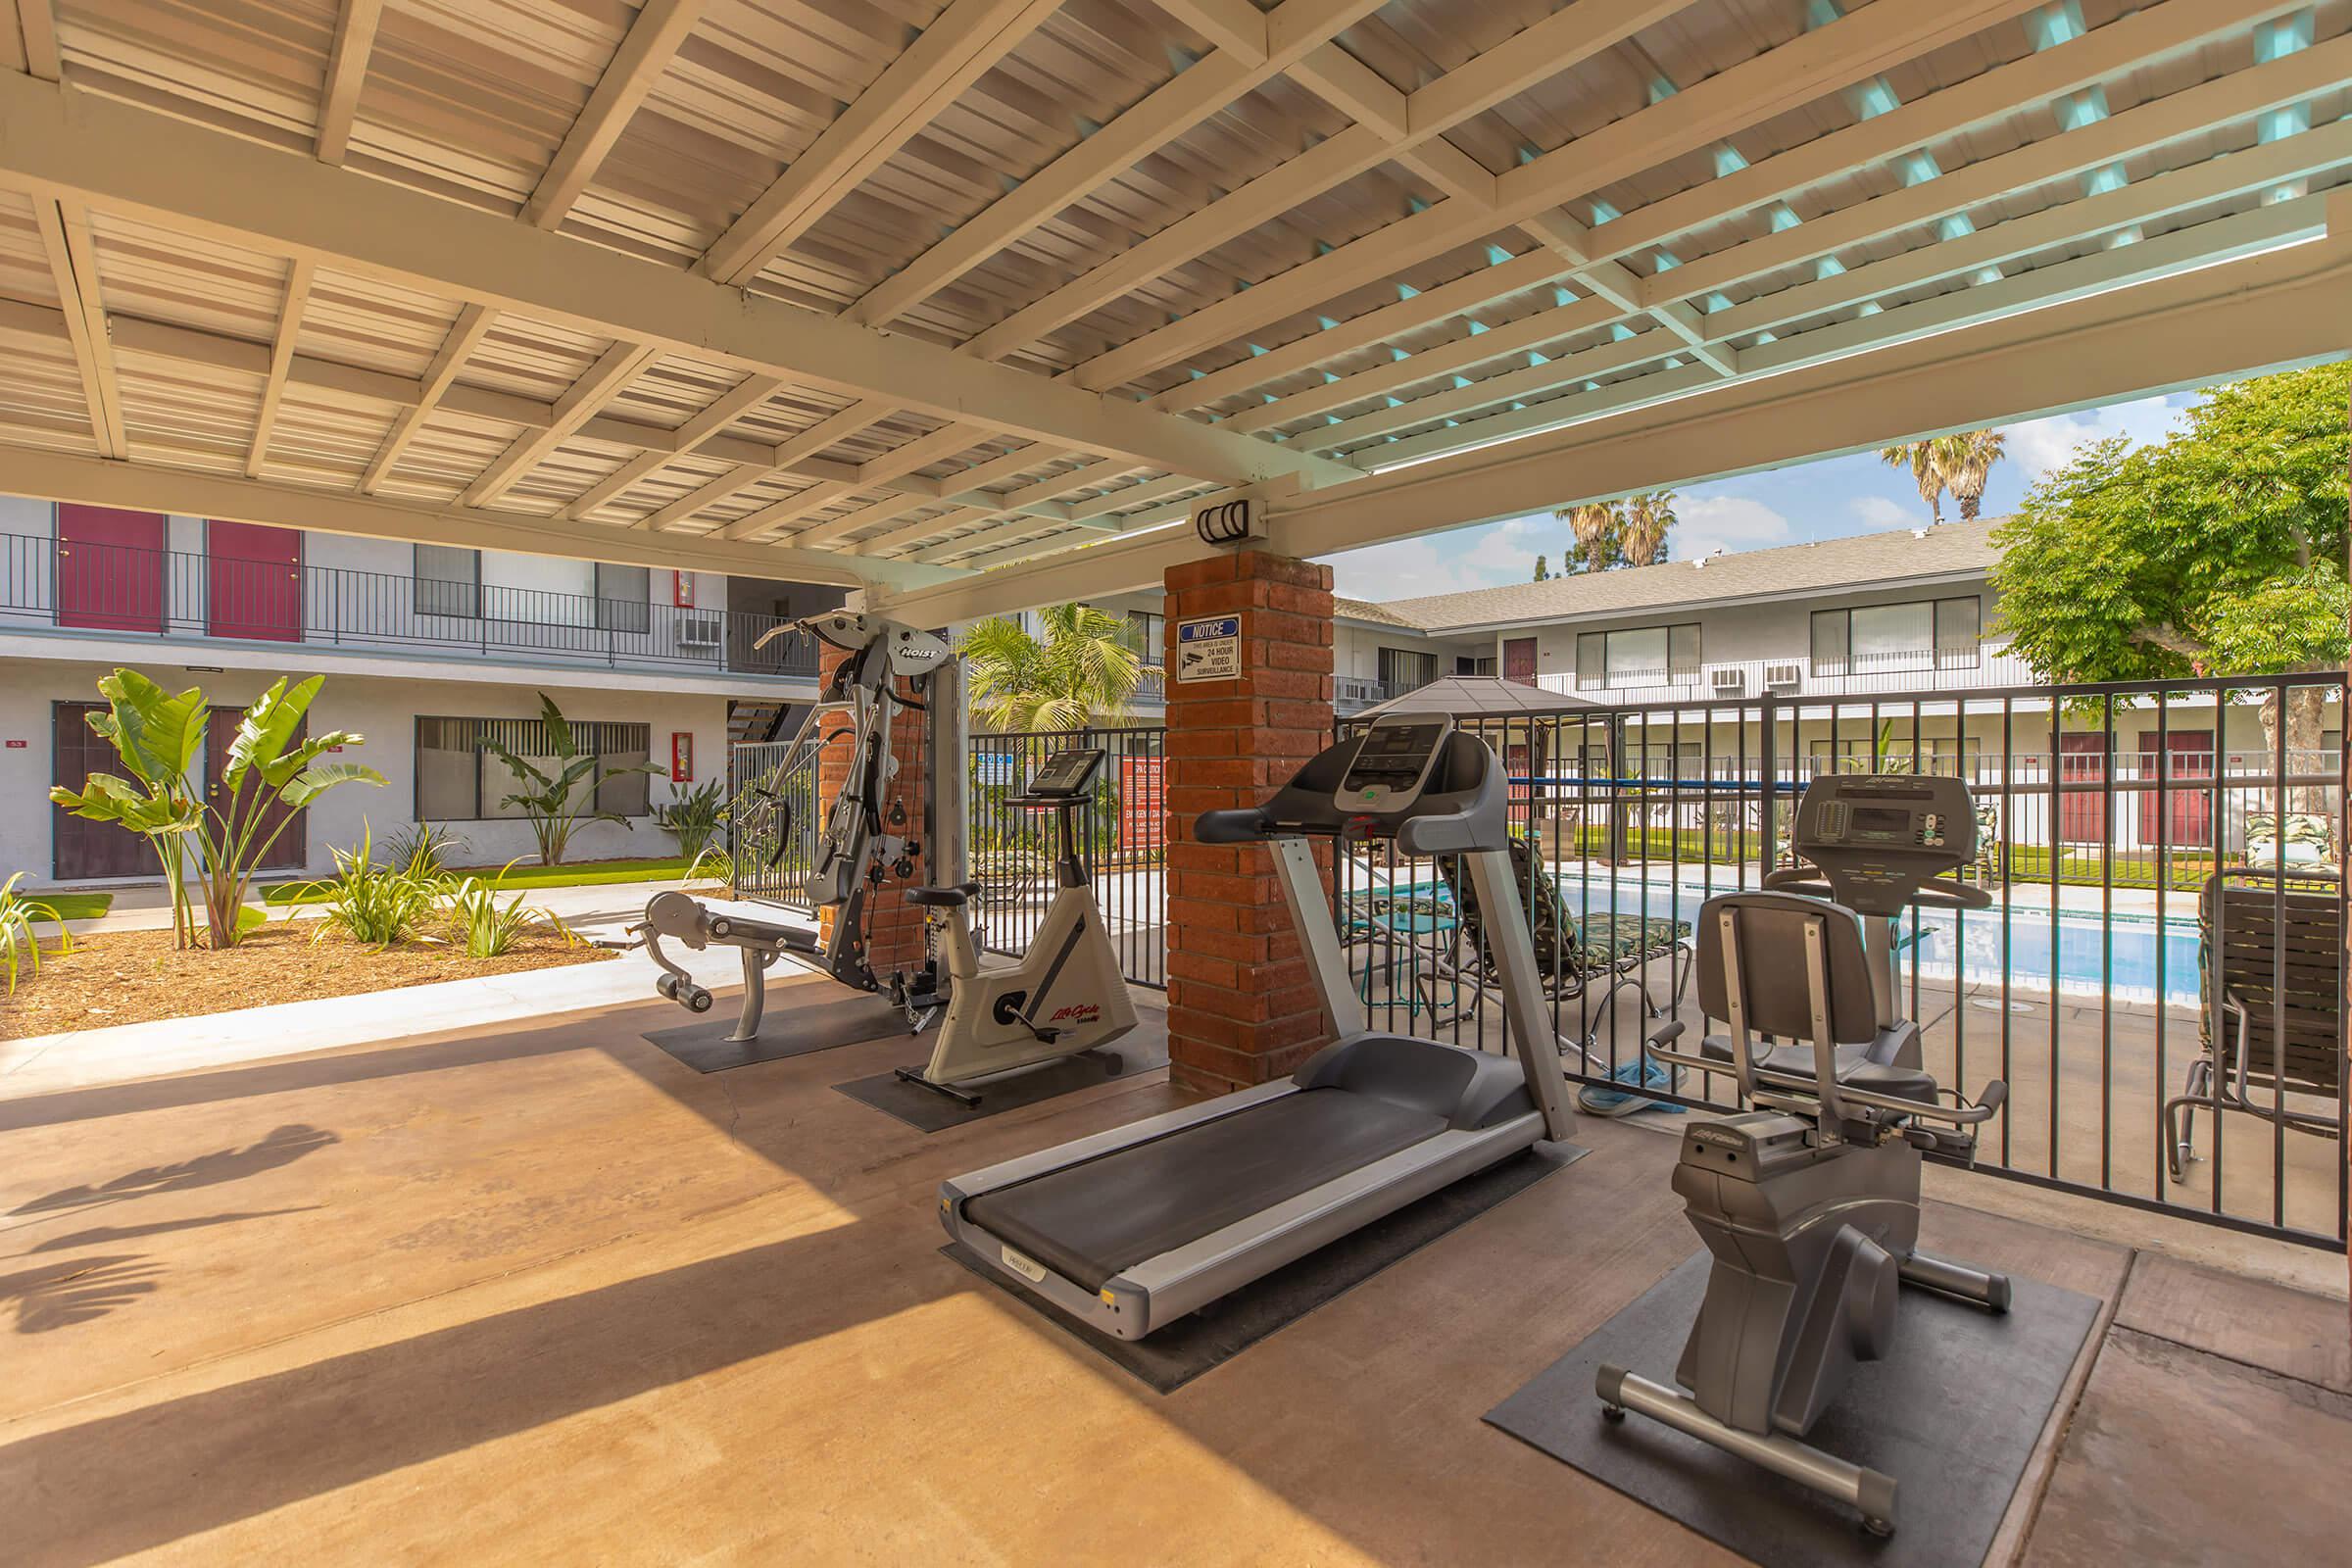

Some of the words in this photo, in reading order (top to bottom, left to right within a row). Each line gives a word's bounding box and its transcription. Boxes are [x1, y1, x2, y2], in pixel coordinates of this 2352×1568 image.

[1193, 622, 1224, 638] NOTICE
[901, 647, 937, 658] HOIST
[1207, 648, 1215, 657] 24
[1216, 647, 1233, 656] HOUR
[1211, 657, 1230, 665] VIDEO
[1197, 665, 1233, 675] SURVEILLANCE
